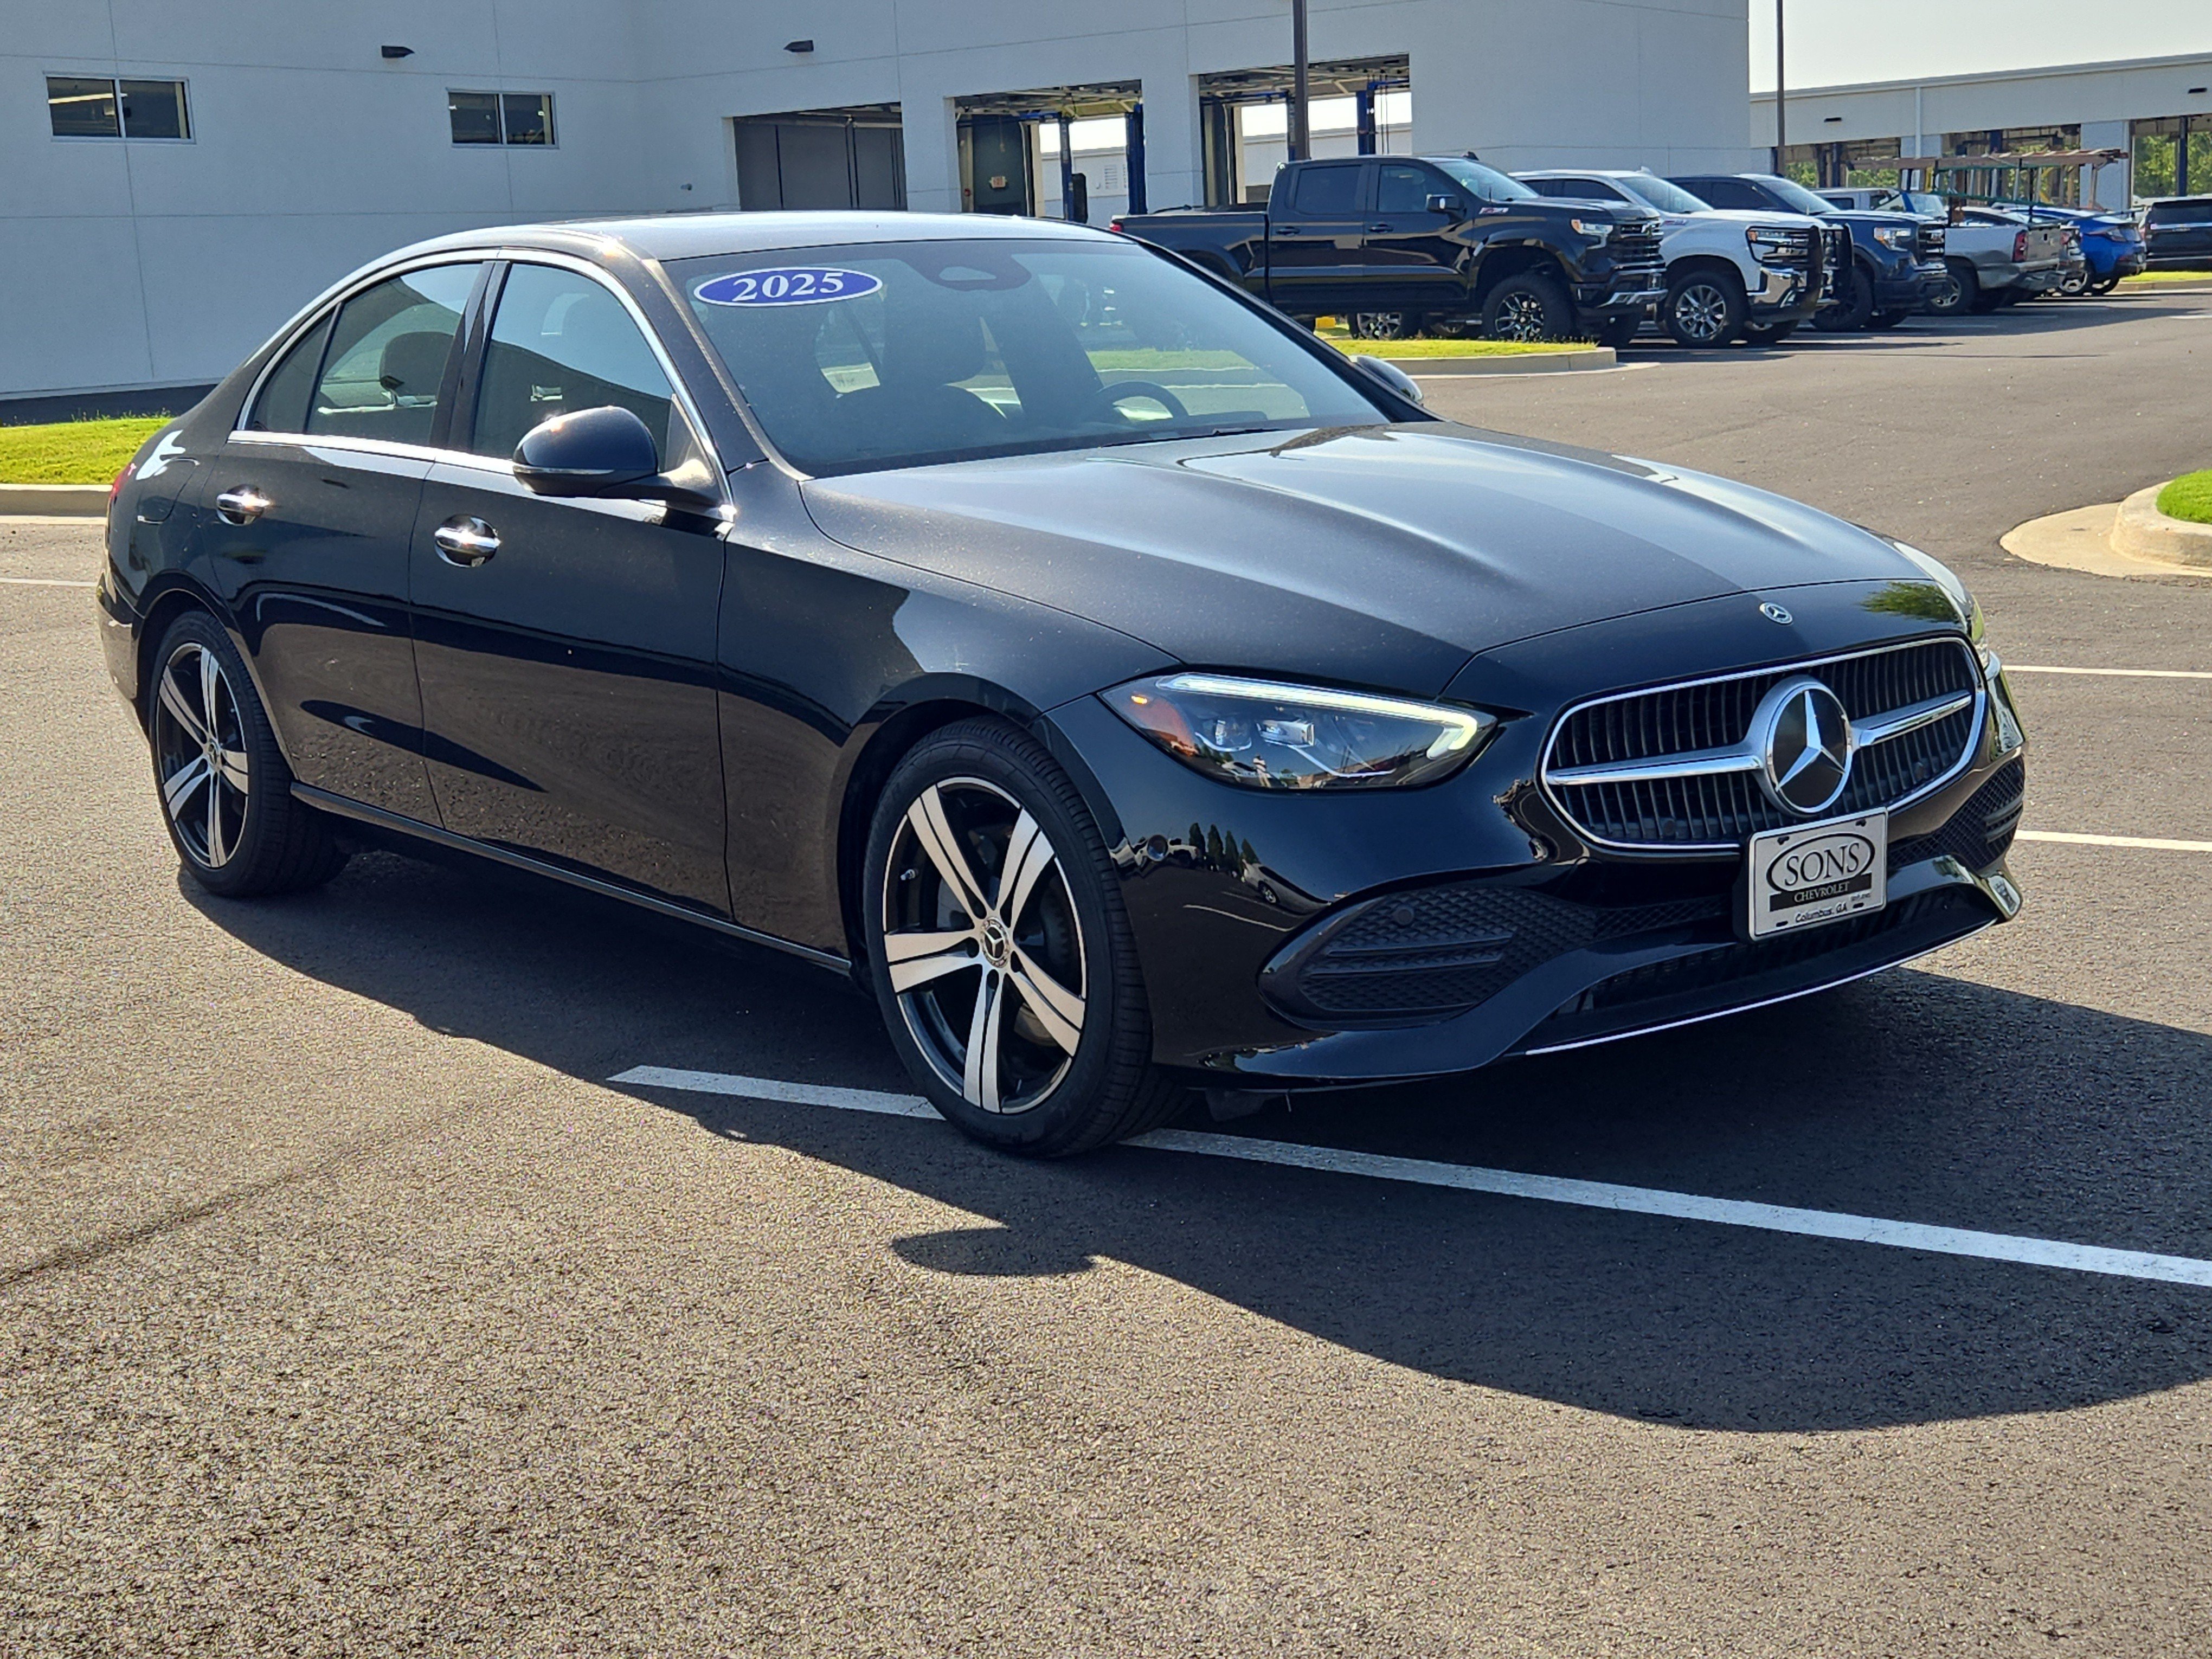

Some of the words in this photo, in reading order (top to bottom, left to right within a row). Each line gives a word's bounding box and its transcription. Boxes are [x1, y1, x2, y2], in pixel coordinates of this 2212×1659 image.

[732, 272, 844, 301] 2025
[1785, 843, 1859, 886] SONS
[1795, 882, 1849, 902] CHEVROLET
[1836, 902, 1847, 913] GA
